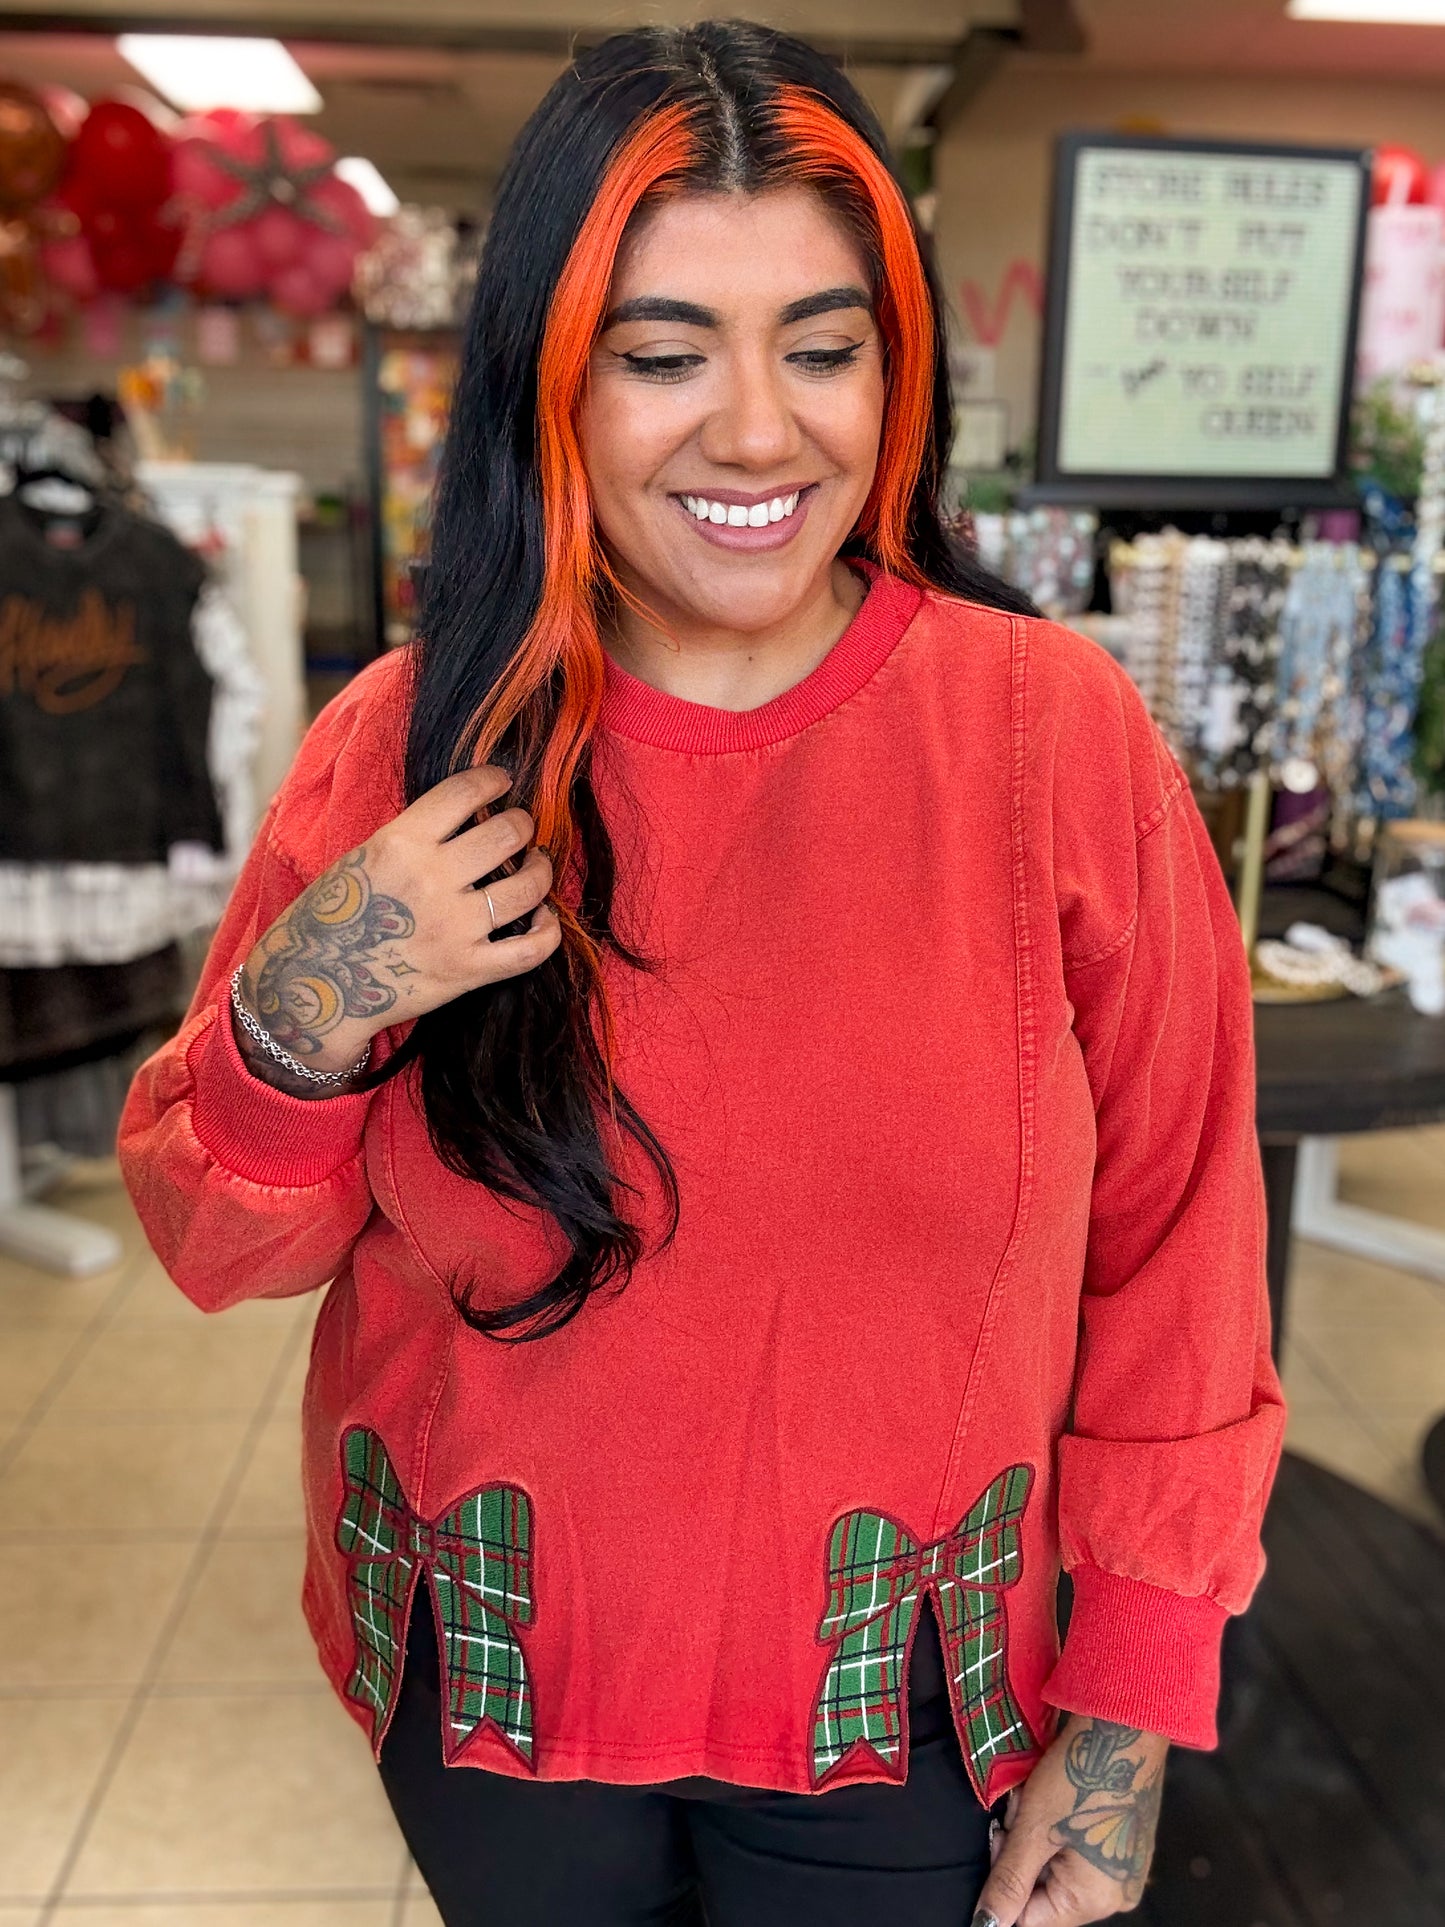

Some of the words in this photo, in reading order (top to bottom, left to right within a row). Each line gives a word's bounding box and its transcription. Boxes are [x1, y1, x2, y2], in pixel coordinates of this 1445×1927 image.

[1087, 213, 1204, 252] DON'T
[1117, 264, 1293, 306] YOURSELF
[1135, 306, 1259, 344] DOWN
